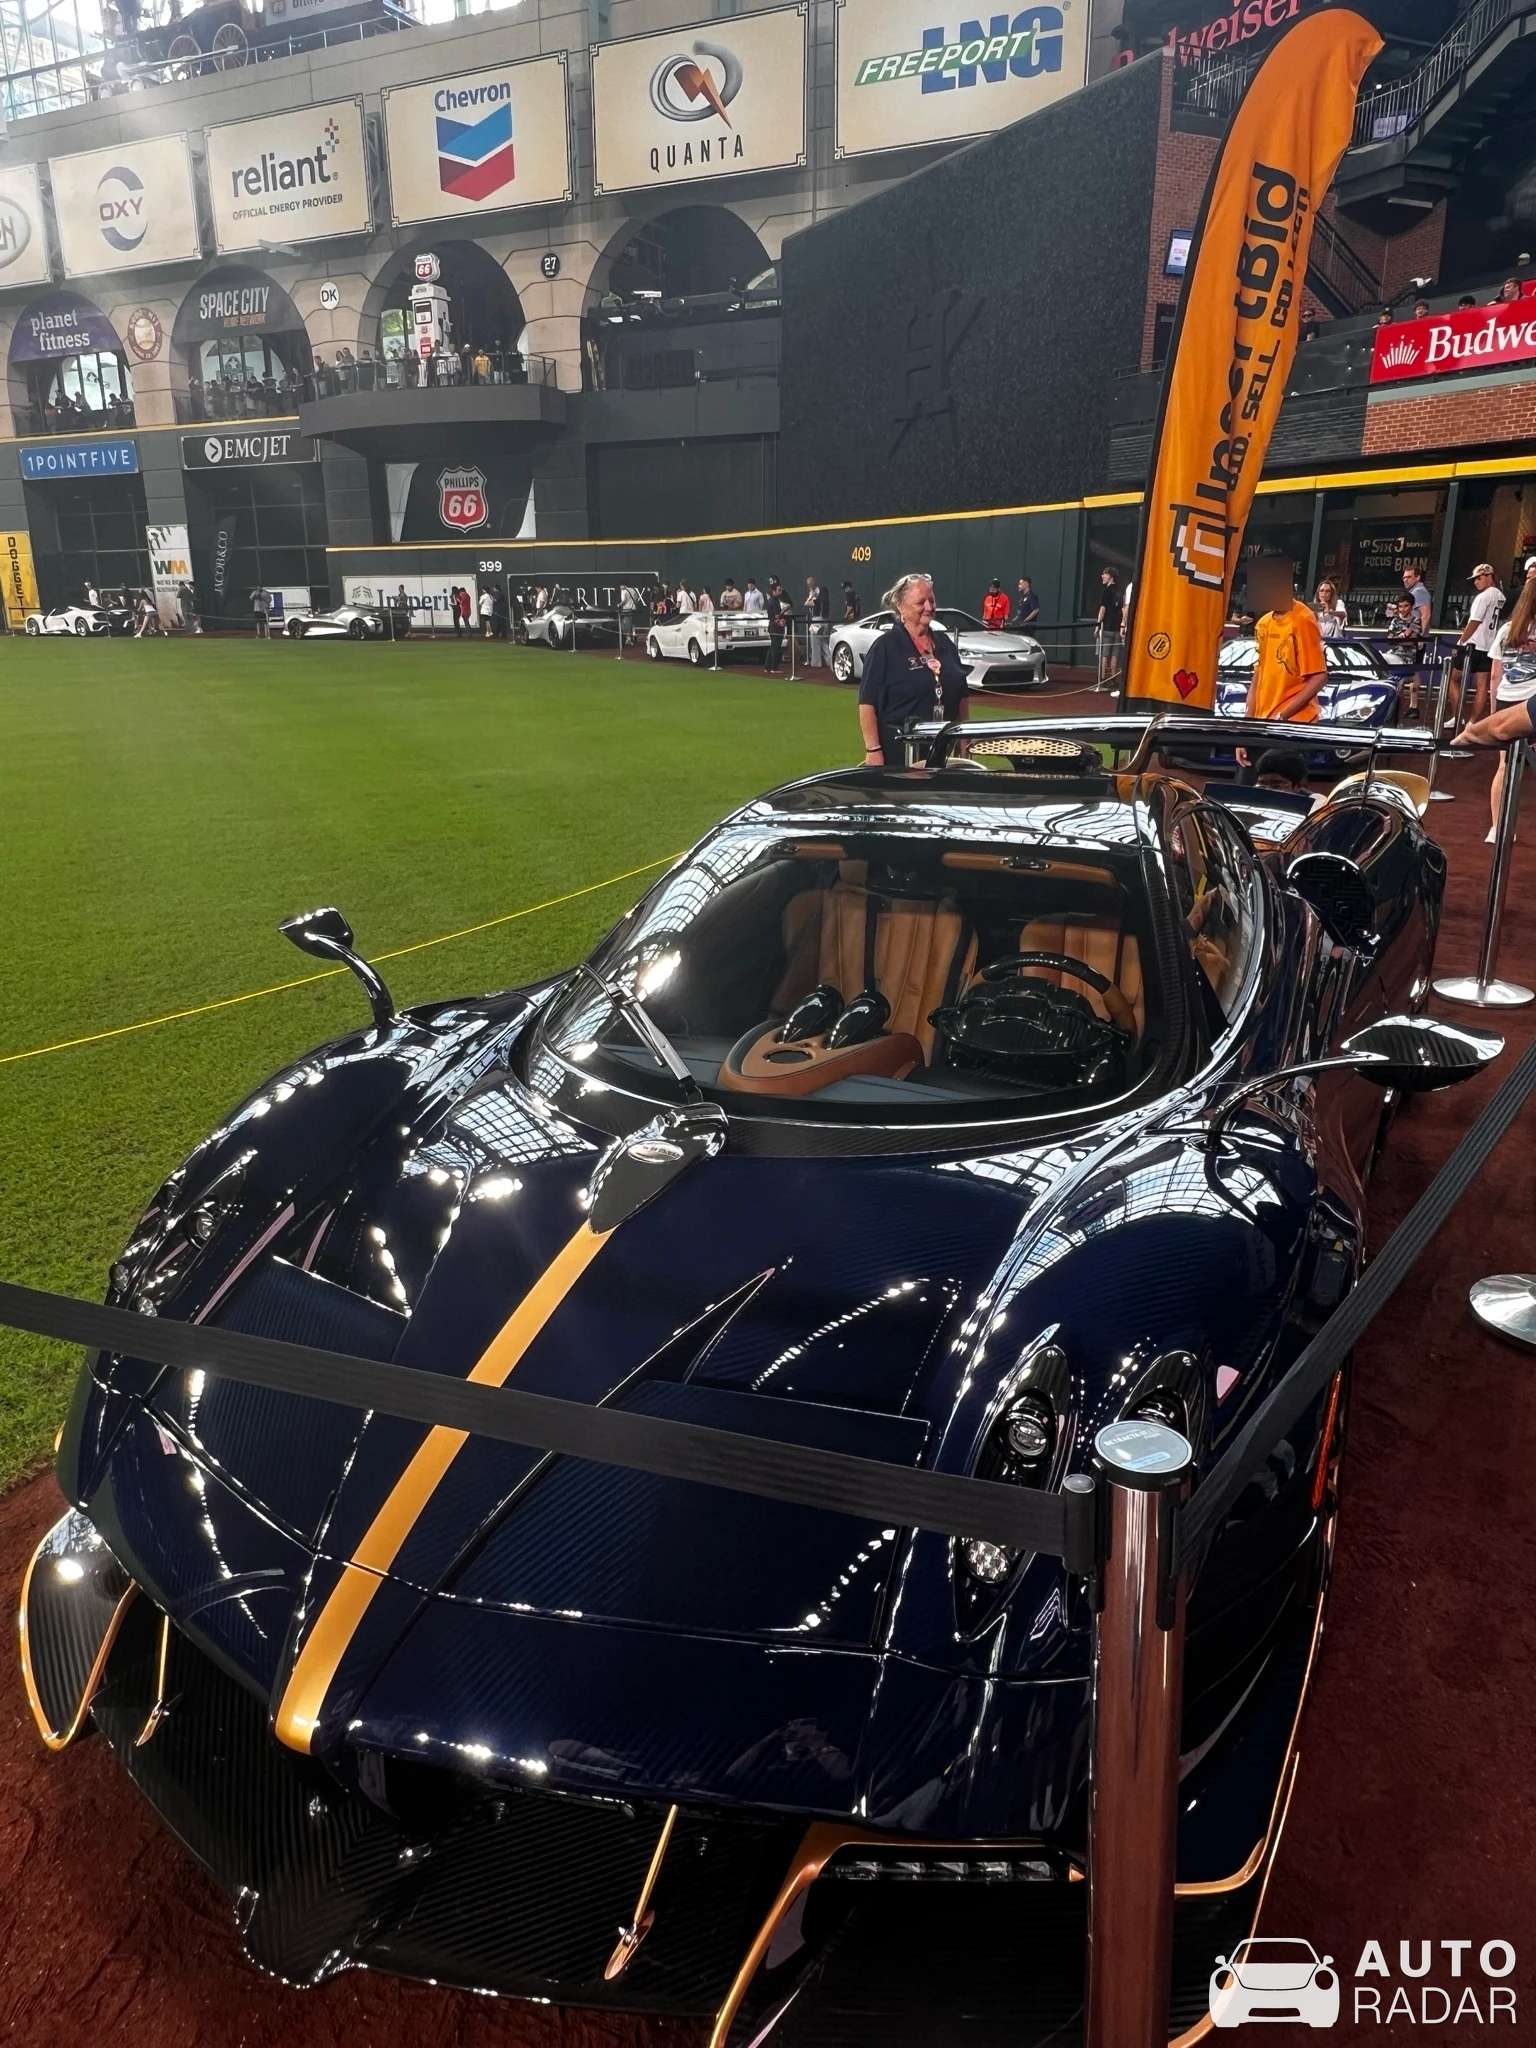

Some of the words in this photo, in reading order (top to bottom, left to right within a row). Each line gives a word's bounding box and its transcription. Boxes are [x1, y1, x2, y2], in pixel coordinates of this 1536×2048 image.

[859, 30, 1031, 84] FREEPORT
[921, 6, 1064, 95] LNG
[434, 82, 511, 112] Chevron
[650, 134, 744, 173] QUANTA
[231, 145, 332, 198] reliant
[99, 196, 144, 222] OXY
[232, 206, 268, 221] OFFICIAL
[269, 200, 301, 215] ENERGY
[302, 193, 344, 208] PROVIDER
[418, 264, 431, 275] 66
[544, 256, 557, 271] 27
[199, 289, 240, 320] SPACE
[241, 286, 270, 315] CITY
[321, 289, 338, 303] DK
[30, 308, 79, 337] planet
[39, 331, 91, 351] fitness
[27, 449, 131, 472] 1POINTFIVE
[224, 434, 291, 462] EMCJET
[444, 476, 480, 489] PHILLIPS
[448, 493, 478, 518] 66
[153, 559, 189, 576] WM
[214, 530, 228, 596] JACOB&CO
[479, 560, 503, 573] 399
[851, 546, 872, 562] 409
[7, 536, 26, 618] DOGGETT
